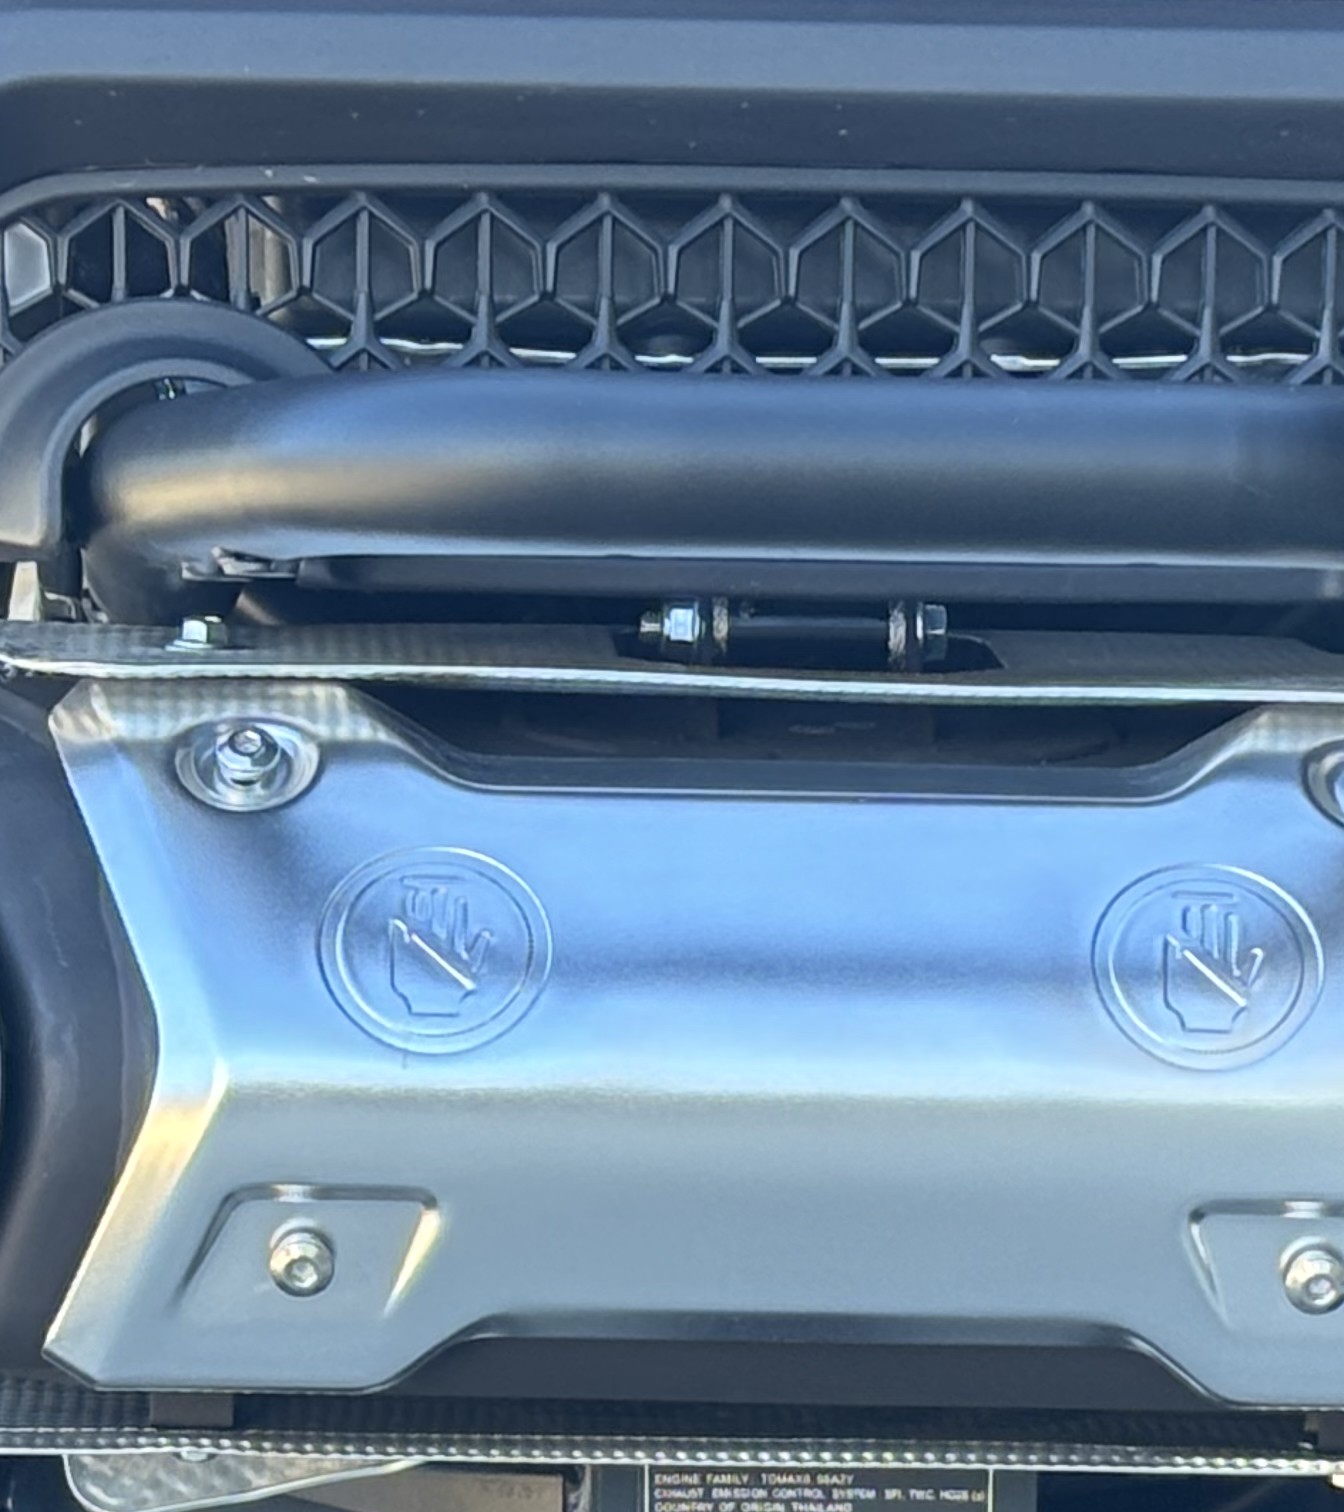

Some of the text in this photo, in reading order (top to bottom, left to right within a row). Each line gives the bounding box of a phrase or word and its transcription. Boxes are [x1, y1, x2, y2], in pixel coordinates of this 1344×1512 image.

[655, 1473, 700, 1485] ENGINE
[654, 1487, 704, 1499] EXHAUST
[712, 1487, 768, 1499] EMISSION
[772, 1487, 826, 1499] CONTROL
[655, 1501, 713, 1512] COUNTRY
[718, 1501, 735, 1512] OF
